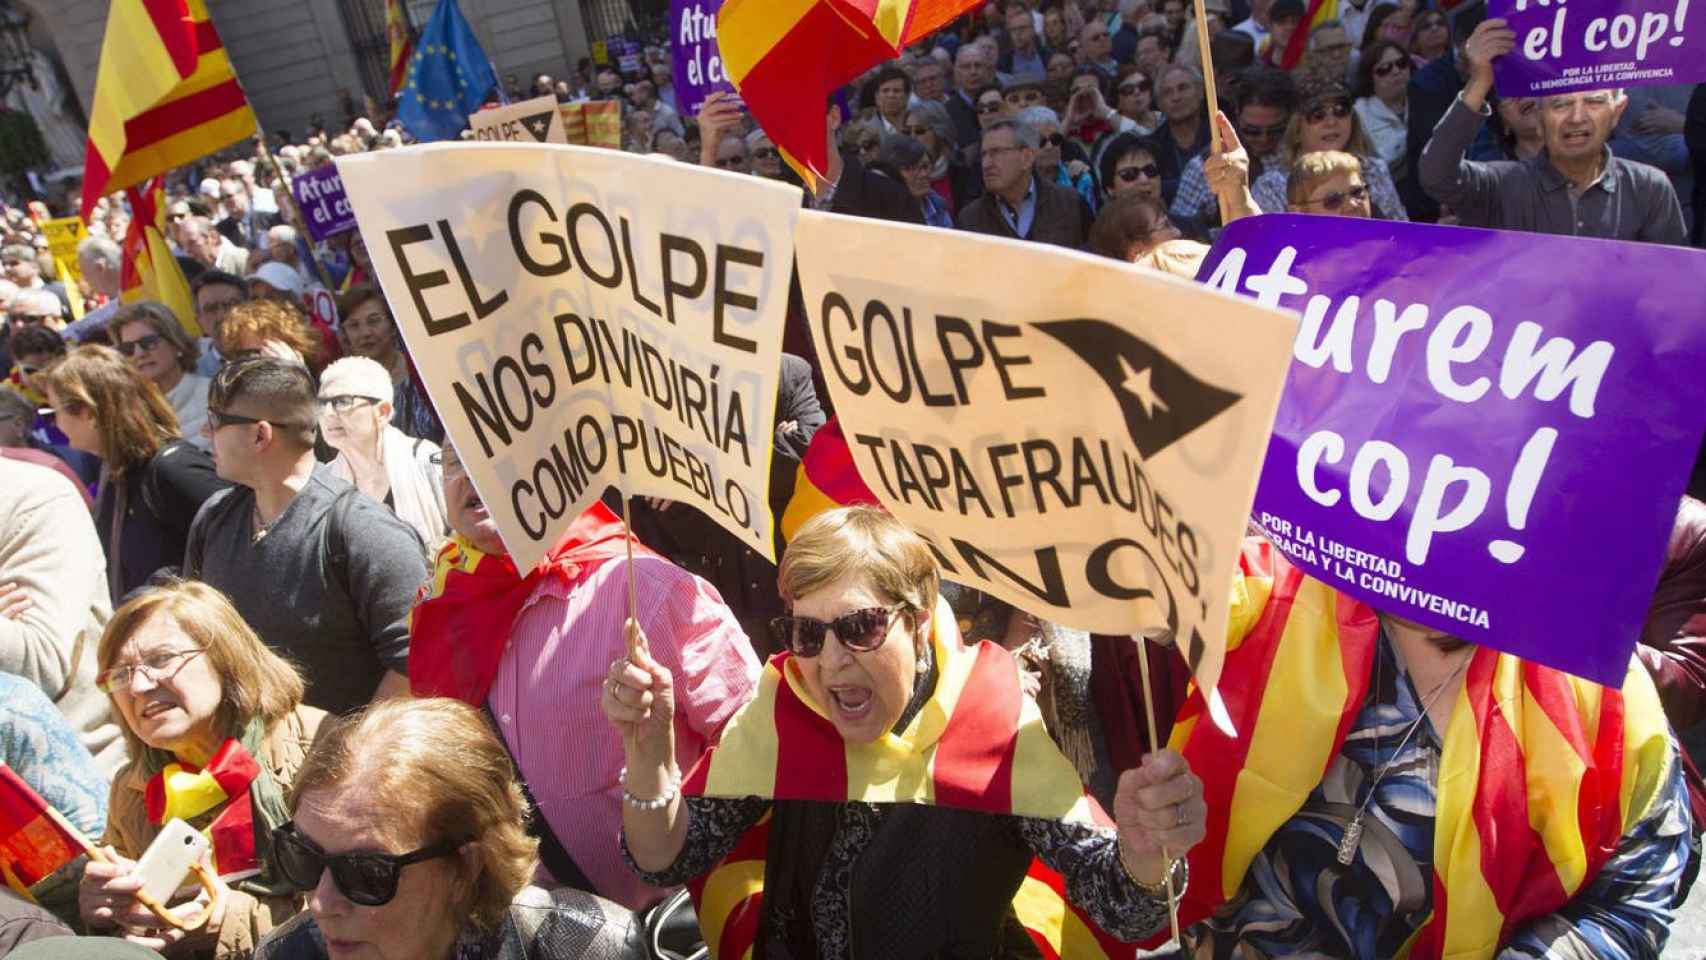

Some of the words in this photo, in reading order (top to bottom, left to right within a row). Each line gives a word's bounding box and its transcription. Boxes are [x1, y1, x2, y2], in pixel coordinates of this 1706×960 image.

[681, 4, 717, 45] Atu
[1523, 7, 1567, 60] el
[1584, 0, 1689, 61] cop!
[688, 45, 704, 85] el
[1530, 82, 1541, 91] LA
[1603, 73, 1614, 82] LA
[1563, 68, 1580, 77] POR
[1582, 66, 1594, 75] LA
[300, 175, 341, 203] Atur
[313, 198, 332, 224] el
[385, 218, 508, 336] EL
[507, 188, 764, 354] GOLPE
[821, 291, 1047, 407] GOLPE
[452, 332, 556, 459] NOS
[554, 312, 752, 467] DIVIDIRÍA
[511, 414, 608, 542] COMO
[612, 415, 761, 539] PUEBLO.
[1296, 427, 1558, 566] cop!
[1262, 511, 1292, 537] POR
[1295, 525, 1316, 548] LA
[1320, 556, 1332, 571] Y
[1335, 562, 1356, 585] LA
[1359, 573, 1491, 630] CONVIVENCIA
